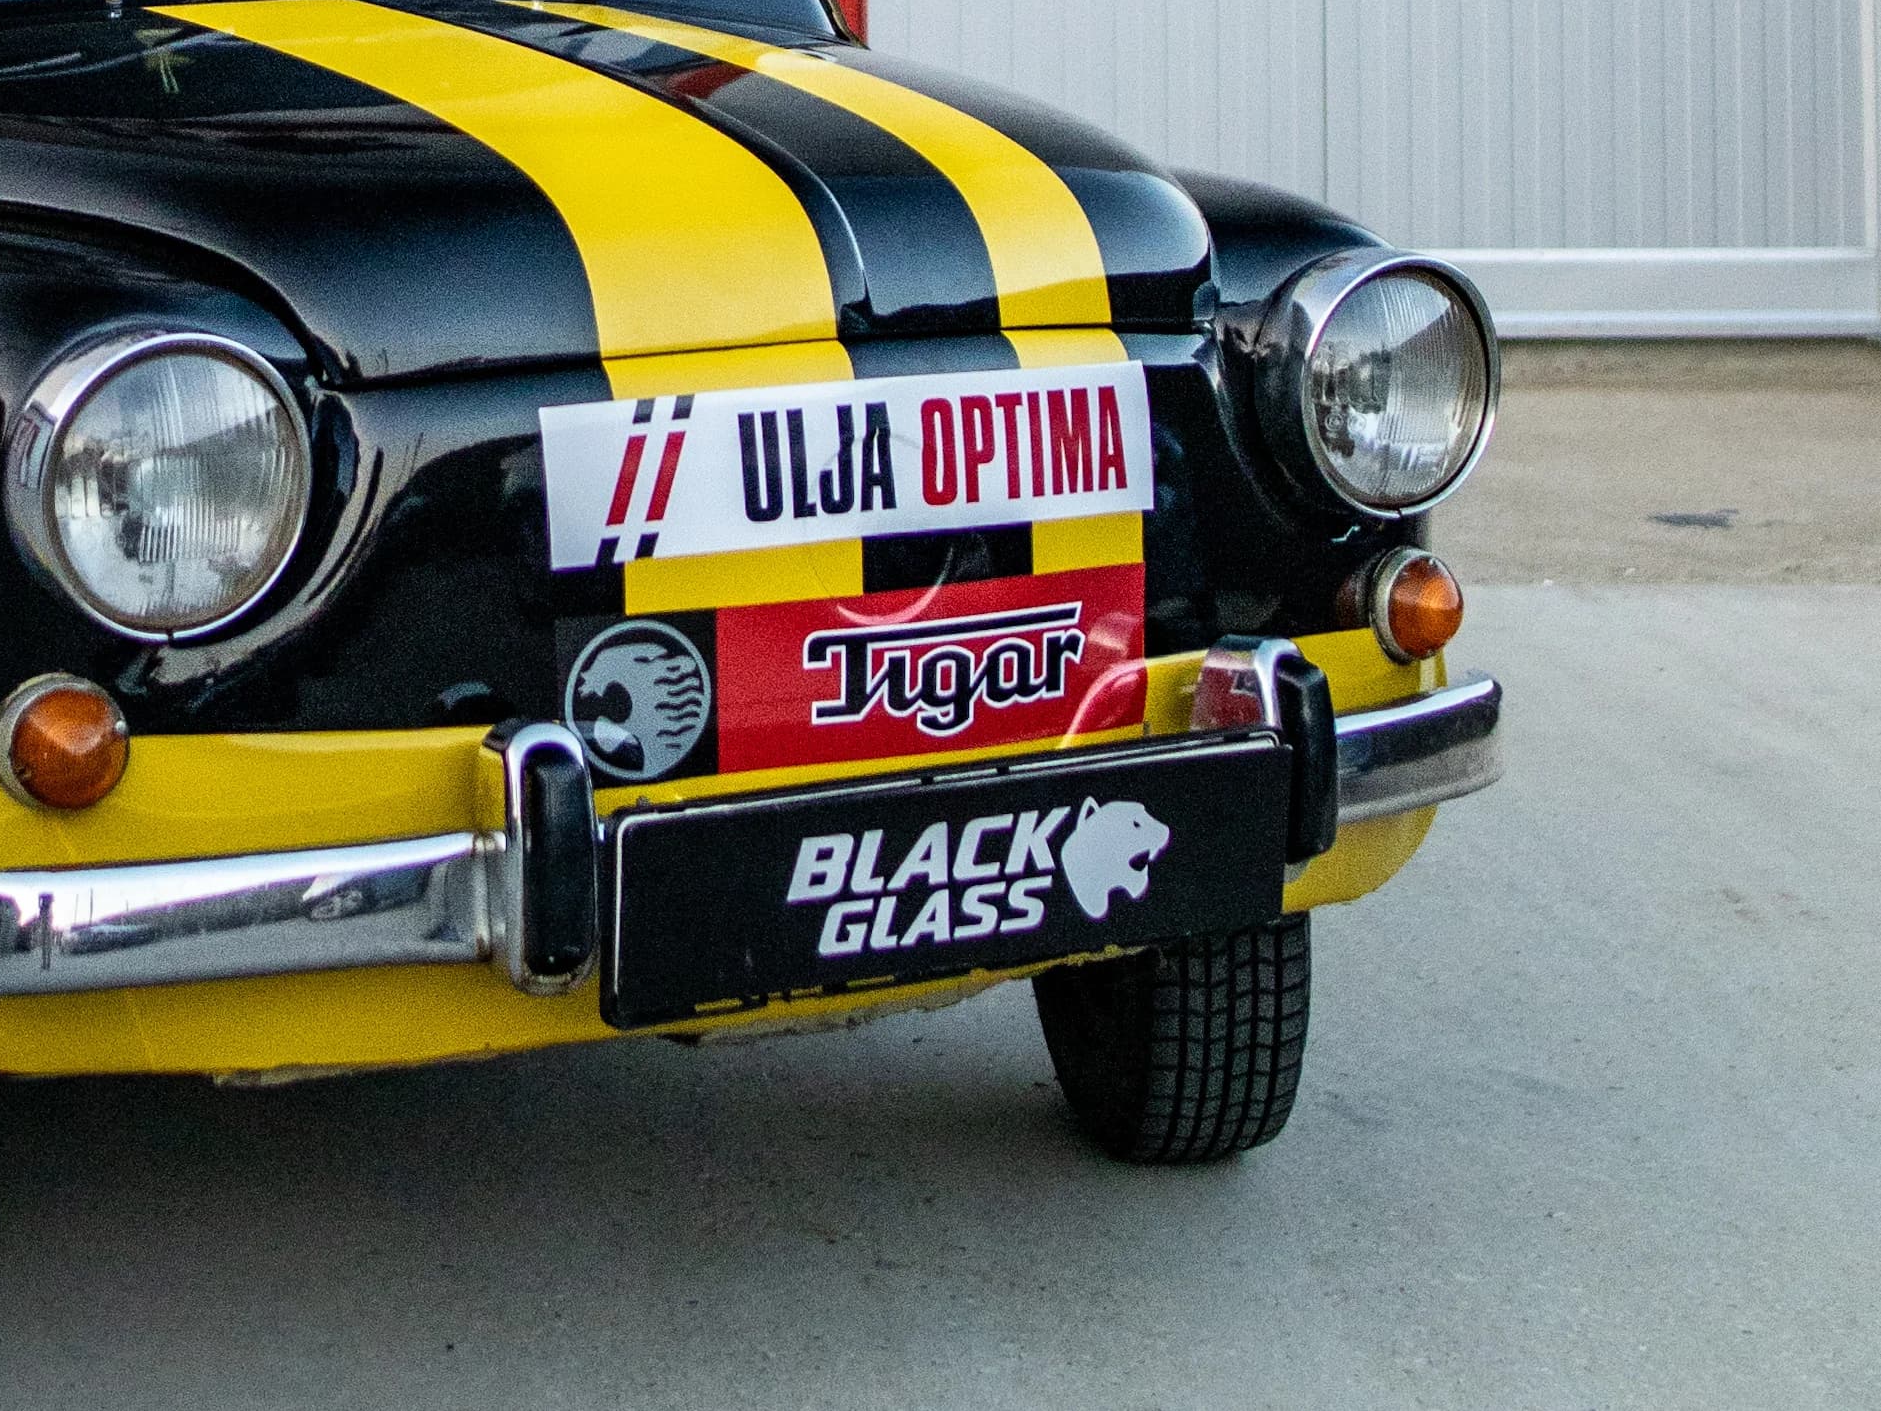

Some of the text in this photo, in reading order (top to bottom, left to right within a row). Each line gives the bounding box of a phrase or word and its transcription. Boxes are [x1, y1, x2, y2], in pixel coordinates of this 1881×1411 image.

[738, 386, 1128, 522] ULJA OPTIMA
[803, 601, 1086, 737] Tigar
[786, 805, 1072, 905] BLACK
[818, 876, 1054, 957] GLASS
